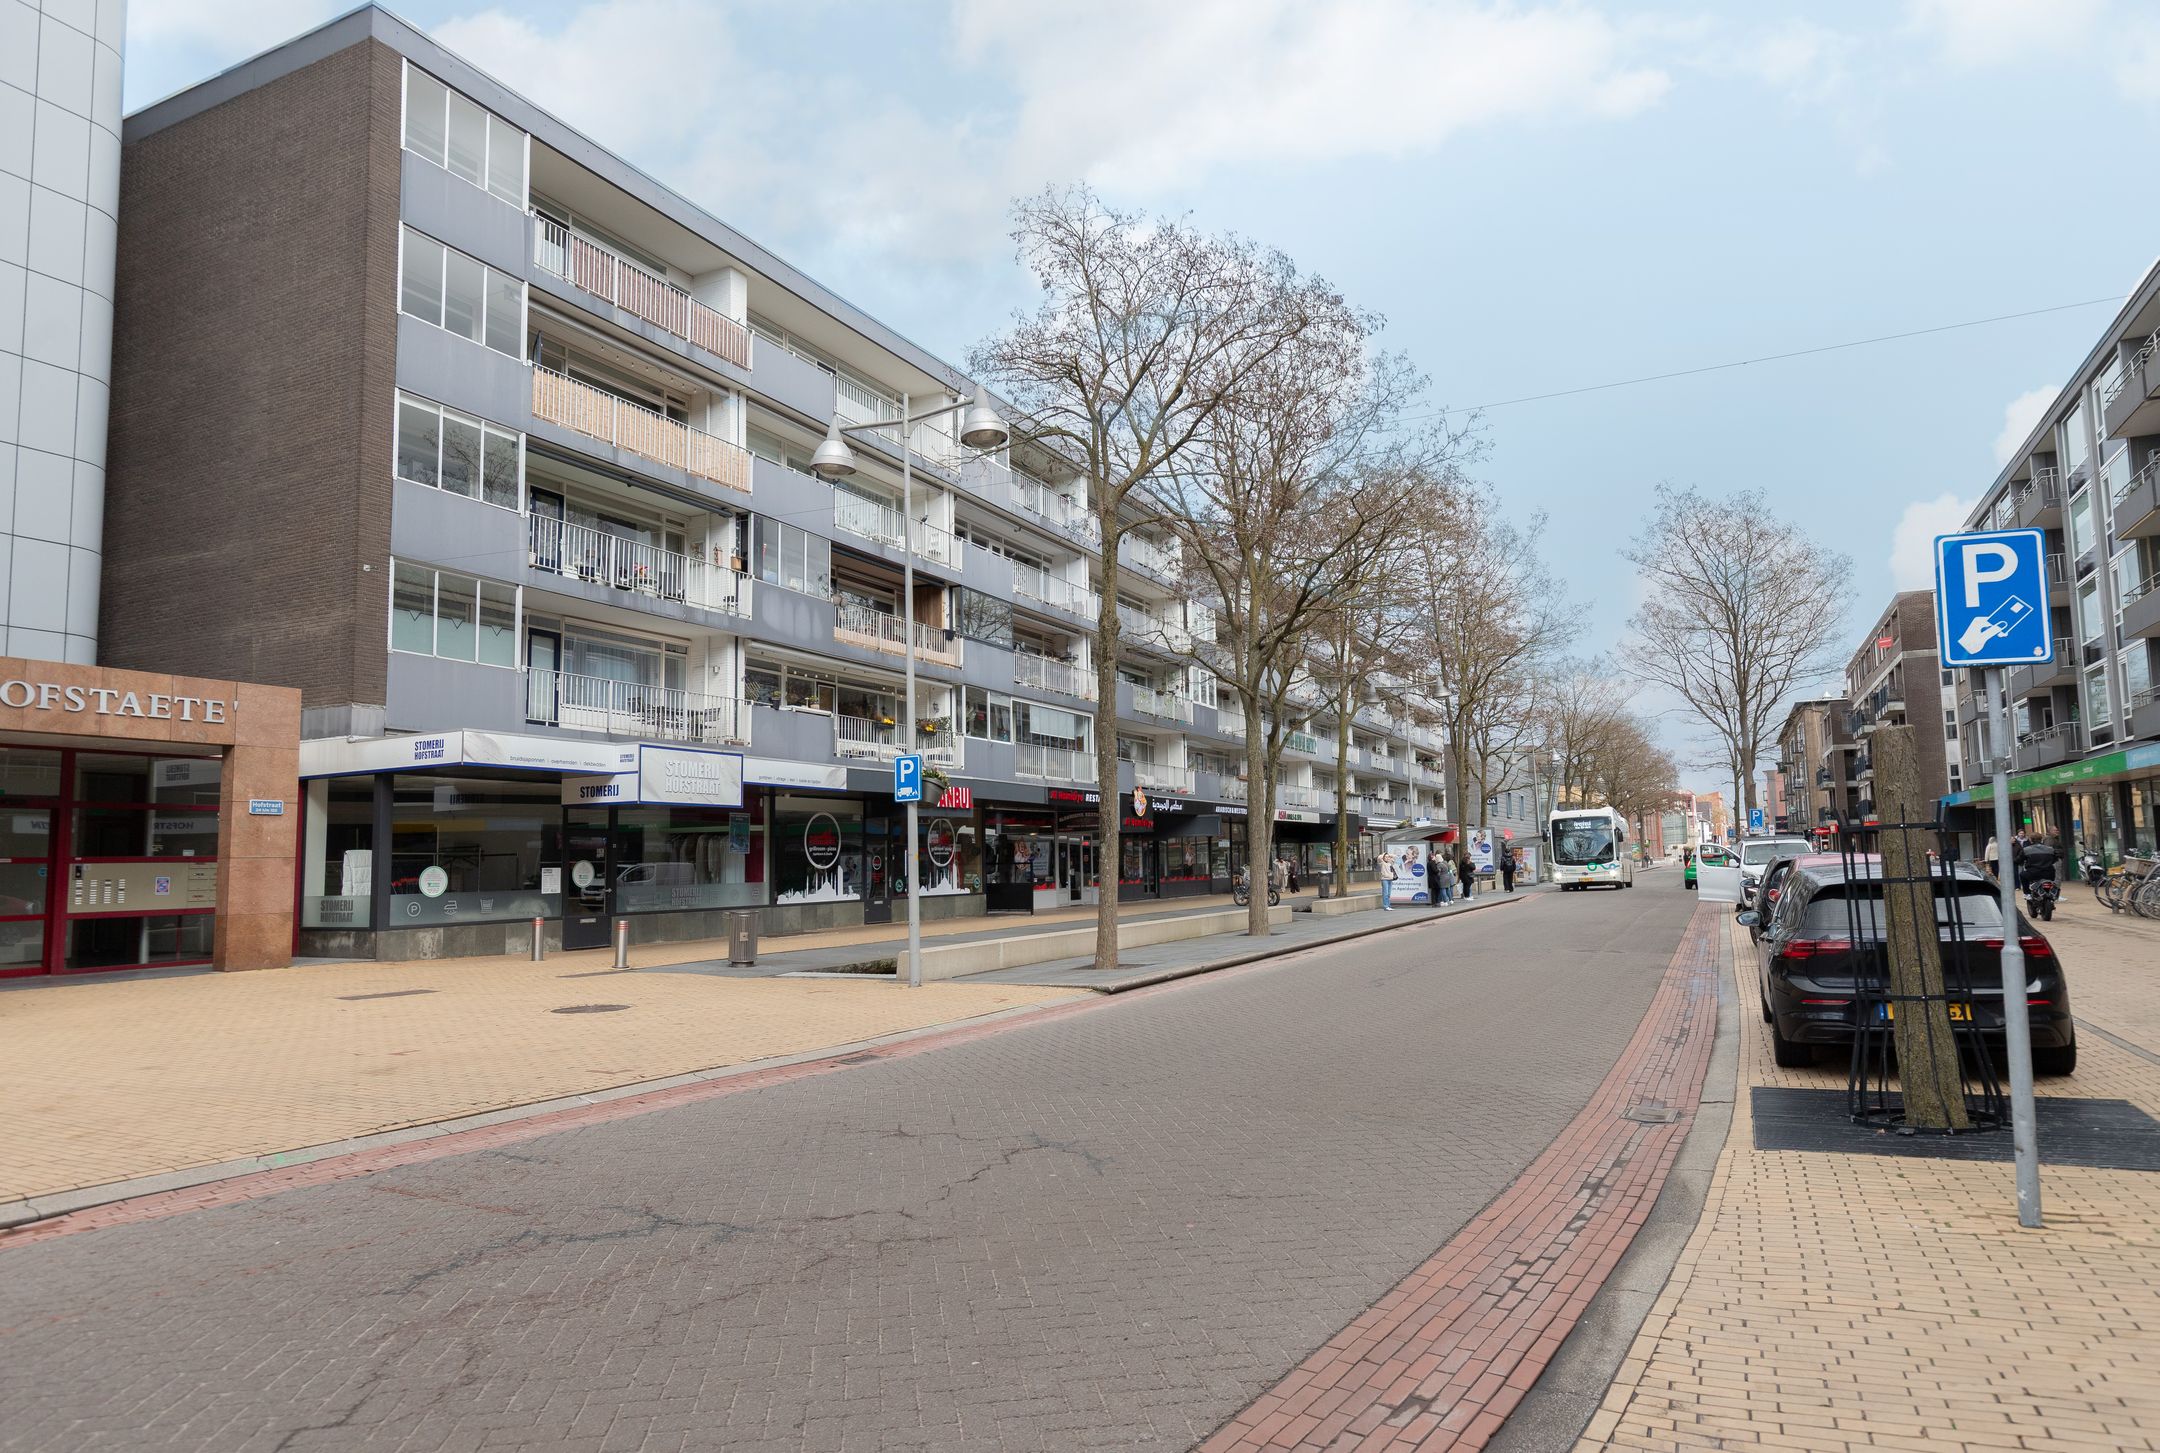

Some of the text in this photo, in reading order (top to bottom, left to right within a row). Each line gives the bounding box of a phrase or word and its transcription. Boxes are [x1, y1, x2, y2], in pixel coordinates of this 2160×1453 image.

[1962, 543, 2018, 608] P
[414, 739, 444, 750] STOMERIJ
[414, 750, 444, 760] HOFSTRAAT
[665, 760, 721, 780] STOMERIJ
[901, 760, 914, 782] P
[580, 785, 619, 798] STOMERIJ
[664, 778, 721, 795] HOFSTRAAT
[936, 787, 973, 808] ANBUL
[1753, 811, 1760, 820] P
[320, 900, 354, 911] STOMERIJ
